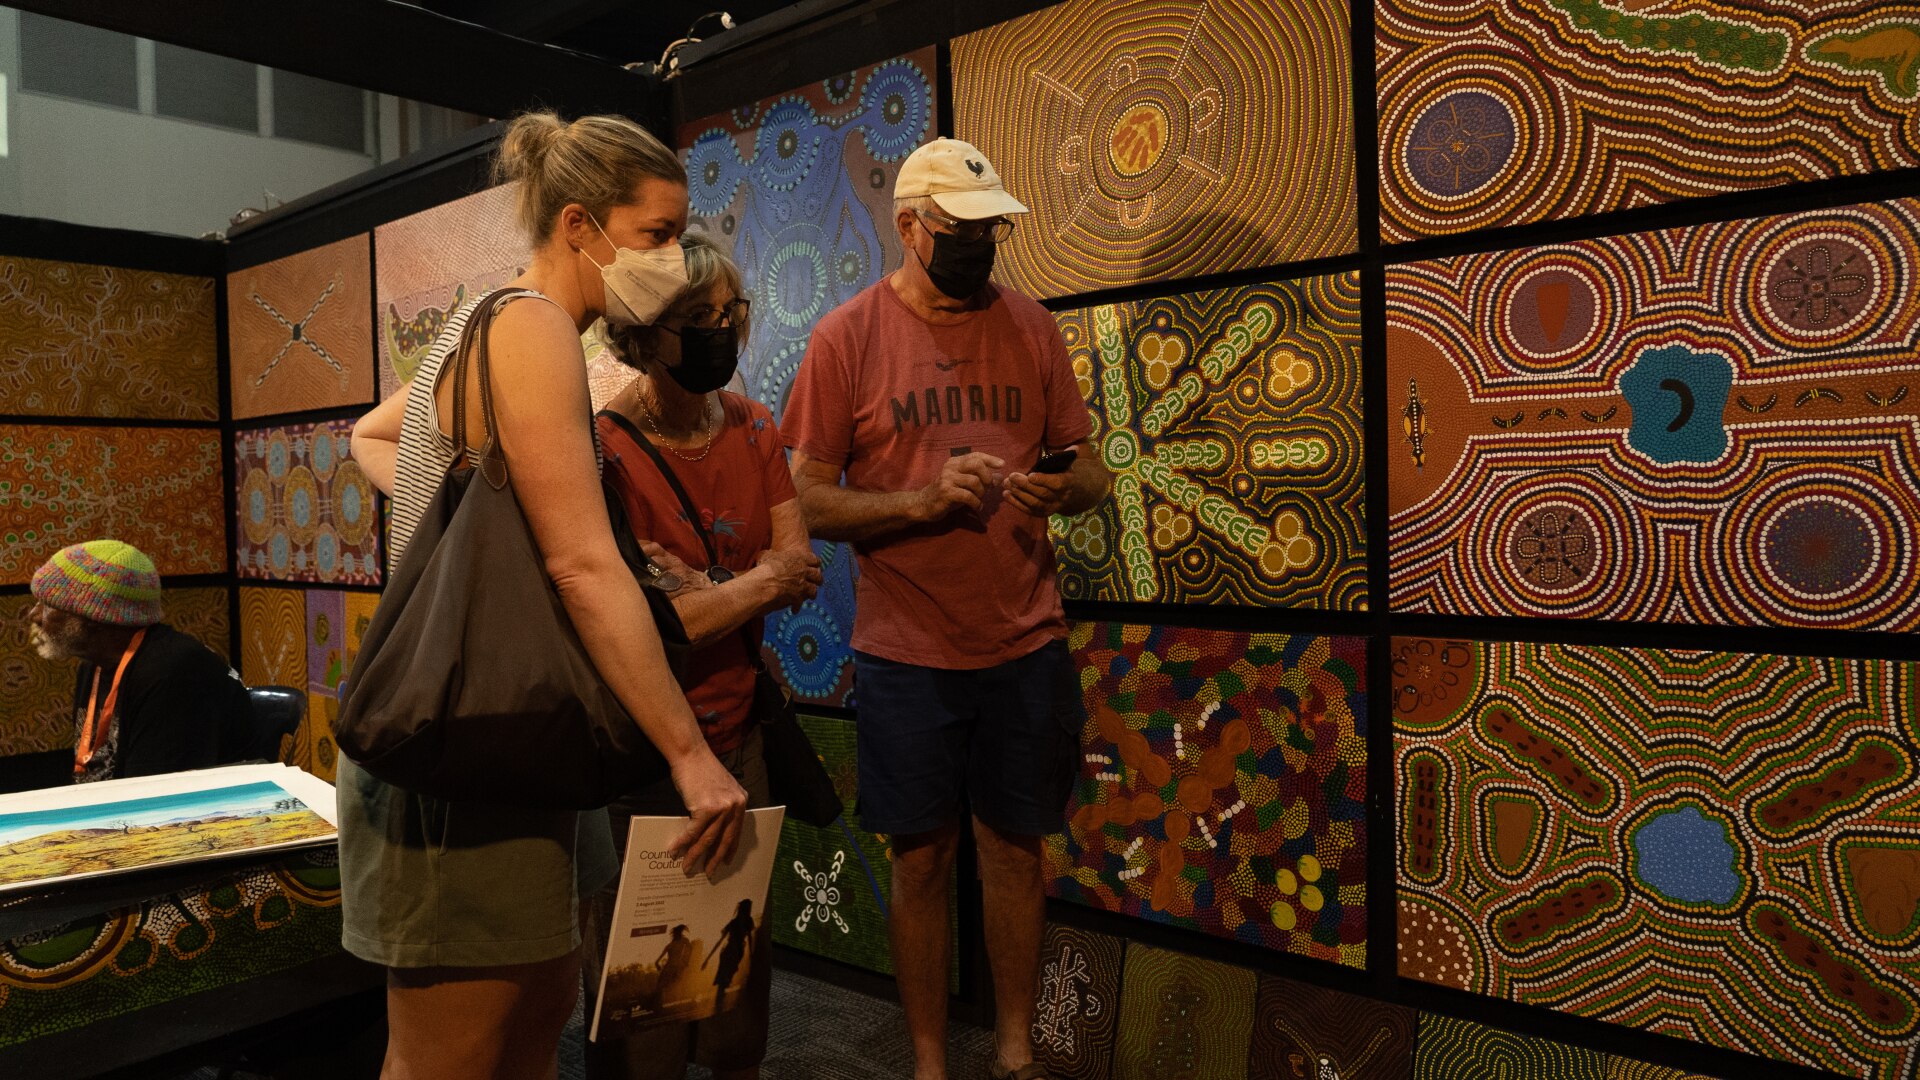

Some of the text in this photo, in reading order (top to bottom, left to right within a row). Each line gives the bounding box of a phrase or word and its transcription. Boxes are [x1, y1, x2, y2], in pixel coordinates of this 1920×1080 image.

[891, 384, 1022, 432] MADRID
[639, 850, 671, 860] Count
[649, 860, 682, 870] Coutur
